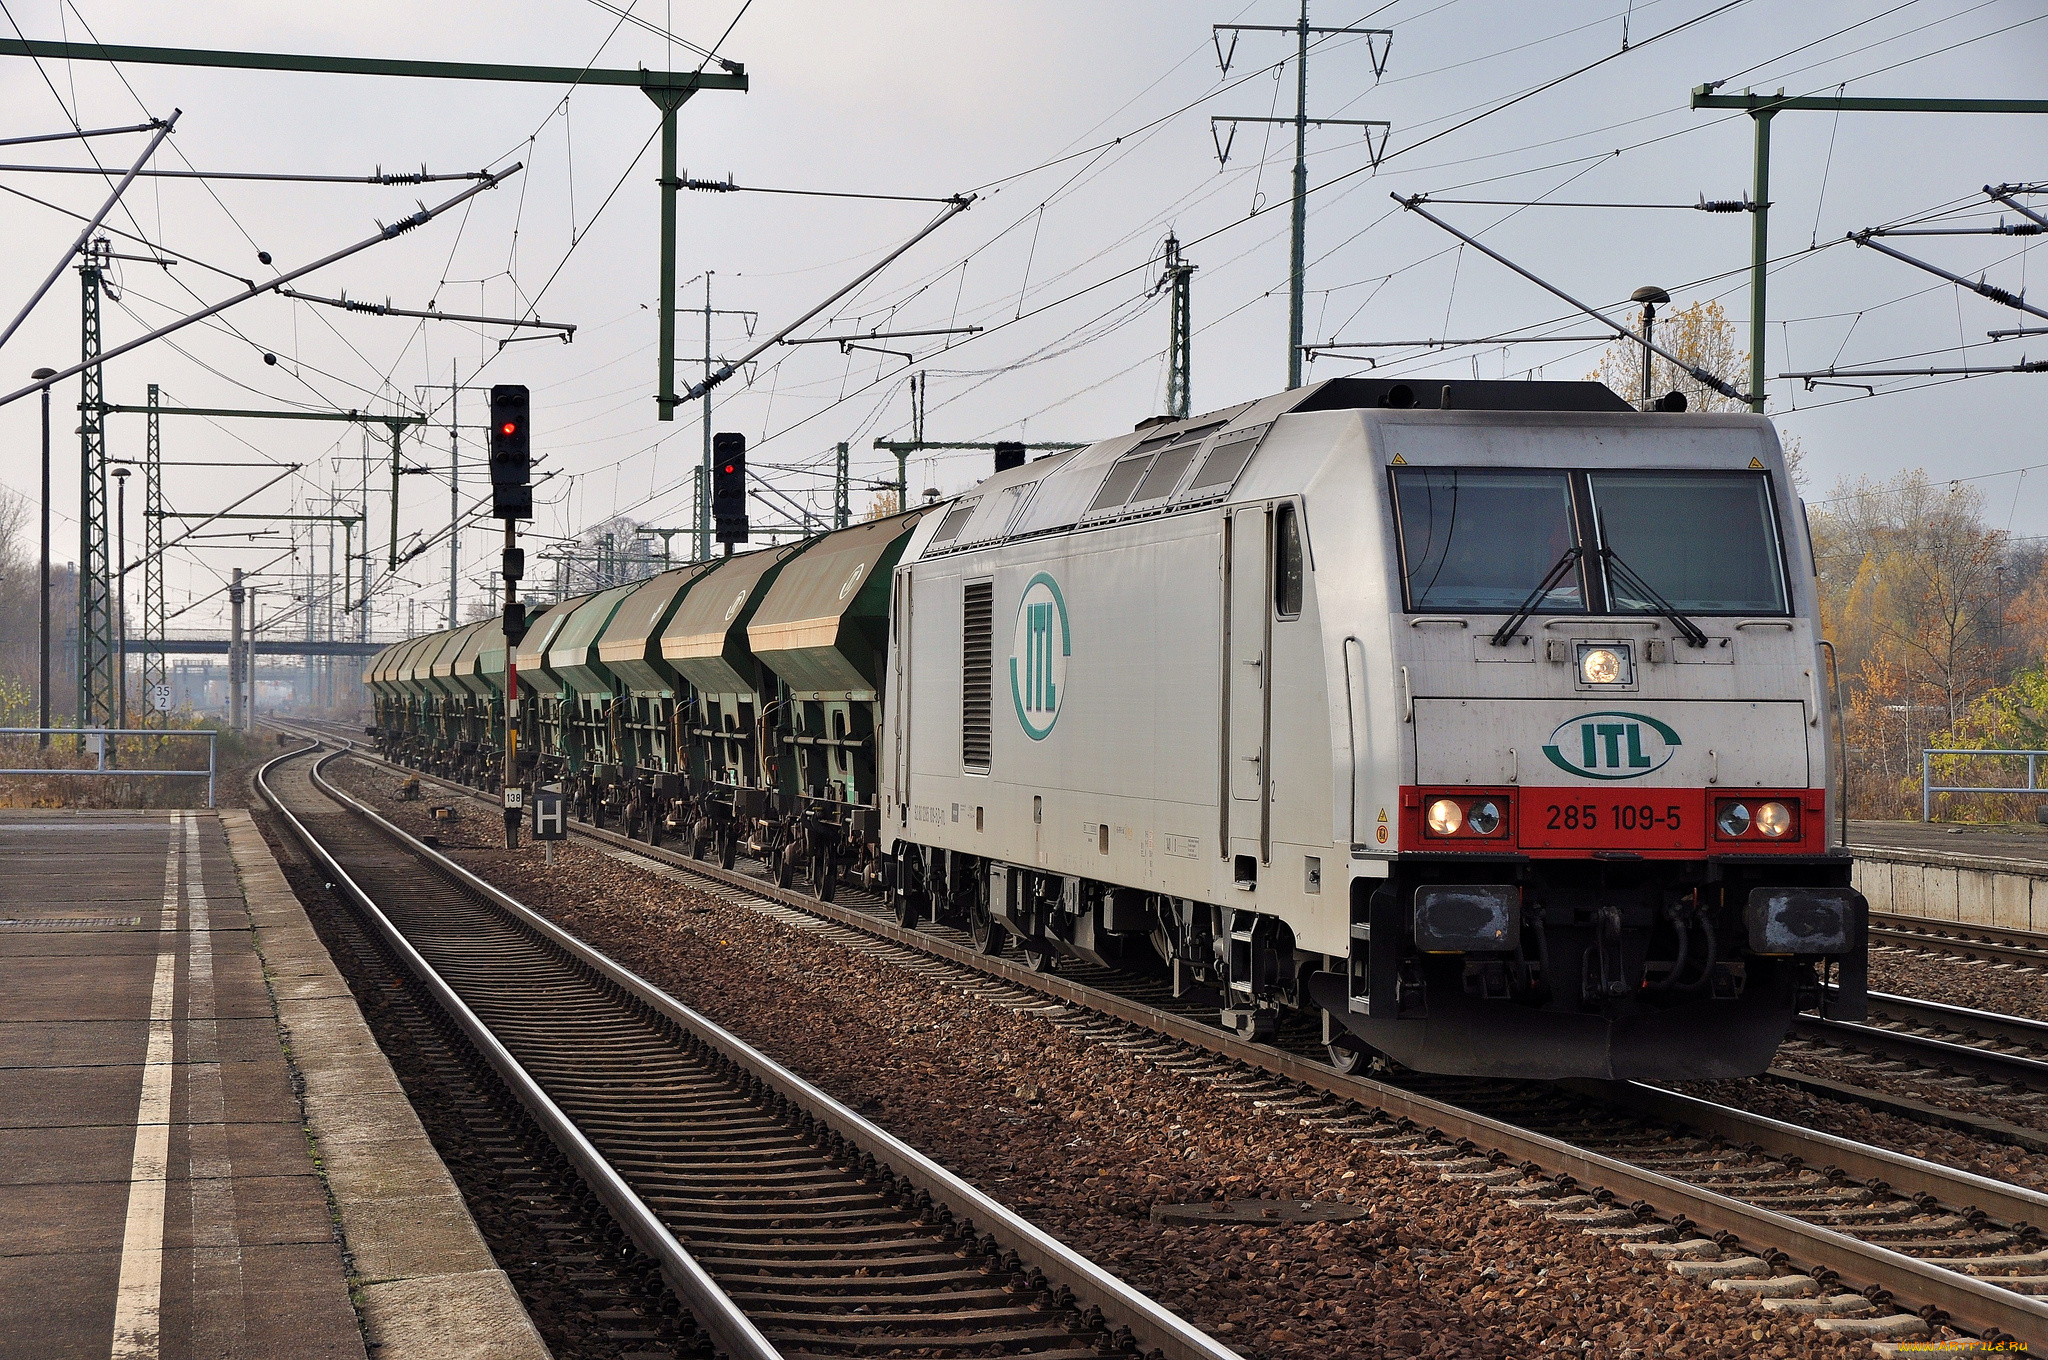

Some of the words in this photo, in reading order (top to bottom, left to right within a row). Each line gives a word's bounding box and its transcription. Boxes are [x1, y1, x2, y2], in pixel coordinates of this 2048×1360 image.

[1026, 602, 1056, 712] ITL
[156, 686, 170, 697] 35
[160, 697, 166, 708] 2
[1581, 723, 1651, 768] ITL
[506, 793, 521, 803] 138
[537, 800, 562, 834] H
[1546, 804, 1597, 830] 285
[1612, 805, 1681, 830] 109-5
